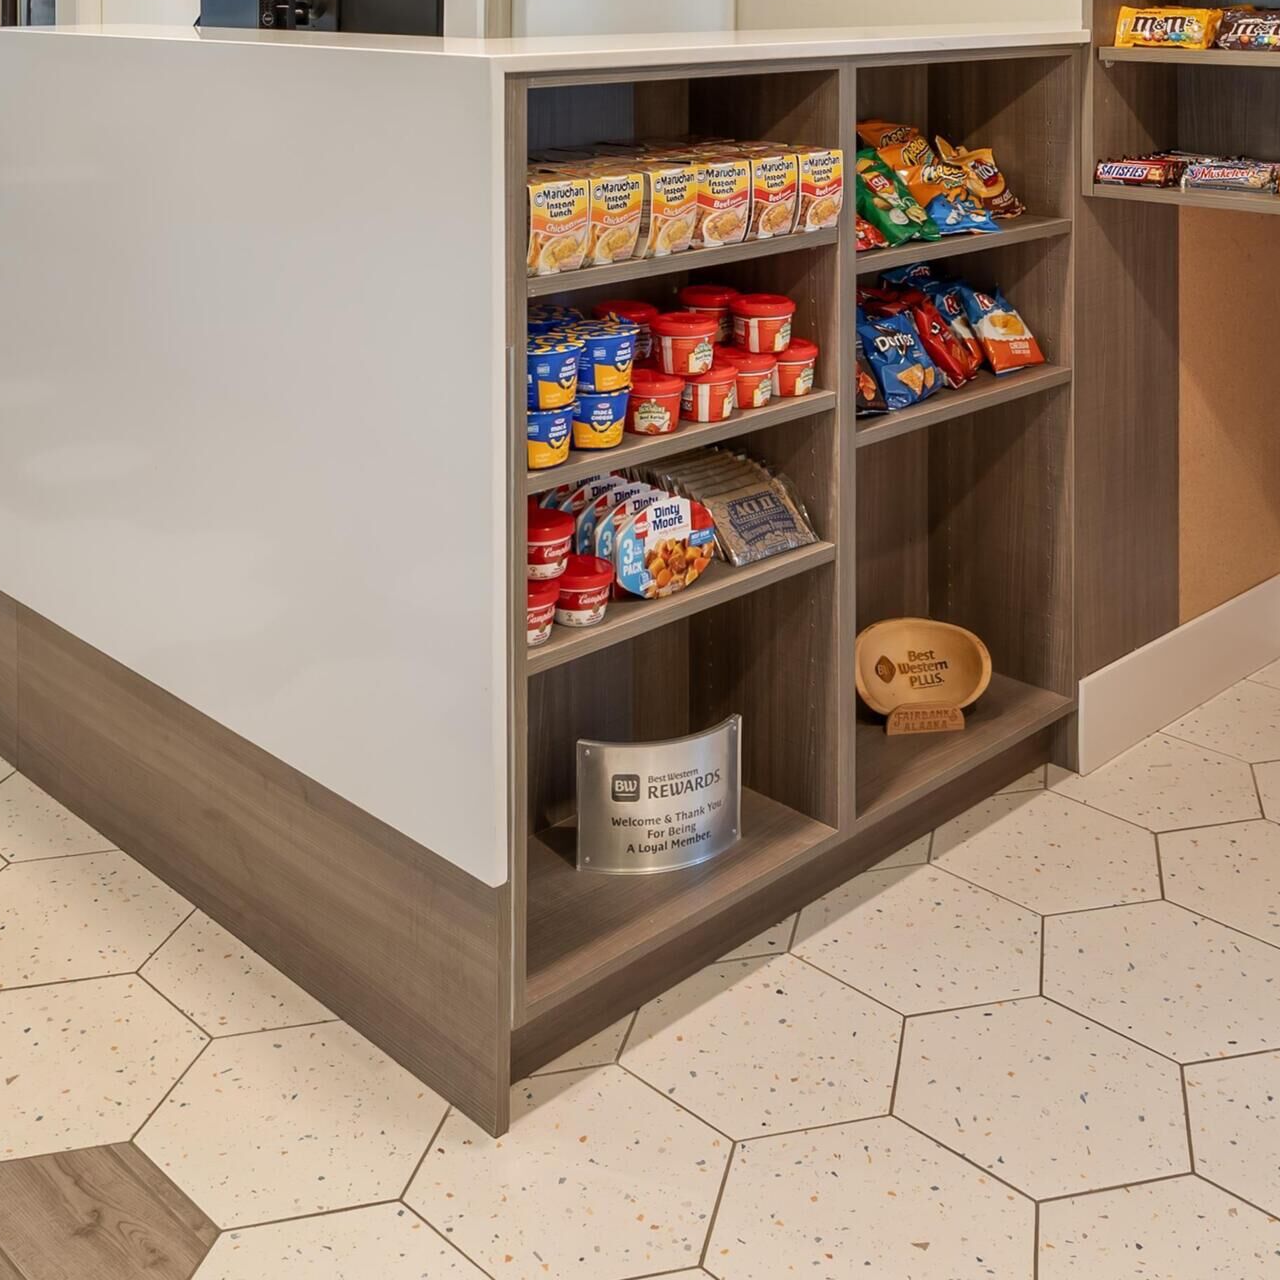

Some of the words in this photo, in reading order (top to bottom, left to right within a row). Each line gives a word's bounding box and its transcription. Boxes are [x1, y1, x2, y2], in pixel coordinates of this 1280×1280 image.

[762, 161, 794, 172] Maruchan
[809, 156, 840, 166] Maruchan
[706, 168, 746, 178] Maruchan
[764, 173, 786, 181] Instant
[811, 168, 832, 176] Instant
[1098, 164, 1148, 178] SATISFIES
[661, 173, 695, 185] Maruchan
[708, 179, 736, 187] Instant
[813, 175, 830, 183] Lunch
[602, 180, 640, 192] Maruchan
[663, 185, 687, 195] Instant
[711, 187, 734, 195] Lunch
[543, 187, 585, 200] Maruchan
[604, 193, 631, 203] Instant
[666, 194, 685, 203] Lunch
[546, 198, 575, 210] Instant
[607, 202, 627, 210] Lunch
[550, 209, 572, 218] Lunch
[875, 333, 914, 352] Doritos
[654, 504, 680, 519] Dinty
[652, 515, 683, 531] Moore
[623, 539, 634, 564] 3
[907, 650, 936, 662] Best
[897, 660, 949, 675] Western
[648, 774, 666, 783] Best
[668, 768, 698, 782] Western
[614, 779, 637, 792] BW
[612, 816, 661, 827] Welcome
[664, 814, 672, 823] &
[675, 806, 705, 822] Thank
[648, 829, 665, 839] For
[668, 822, 696, 837] Being
[626, 844, 635, 854] A
[638, 842, 668, 855] Loyal
